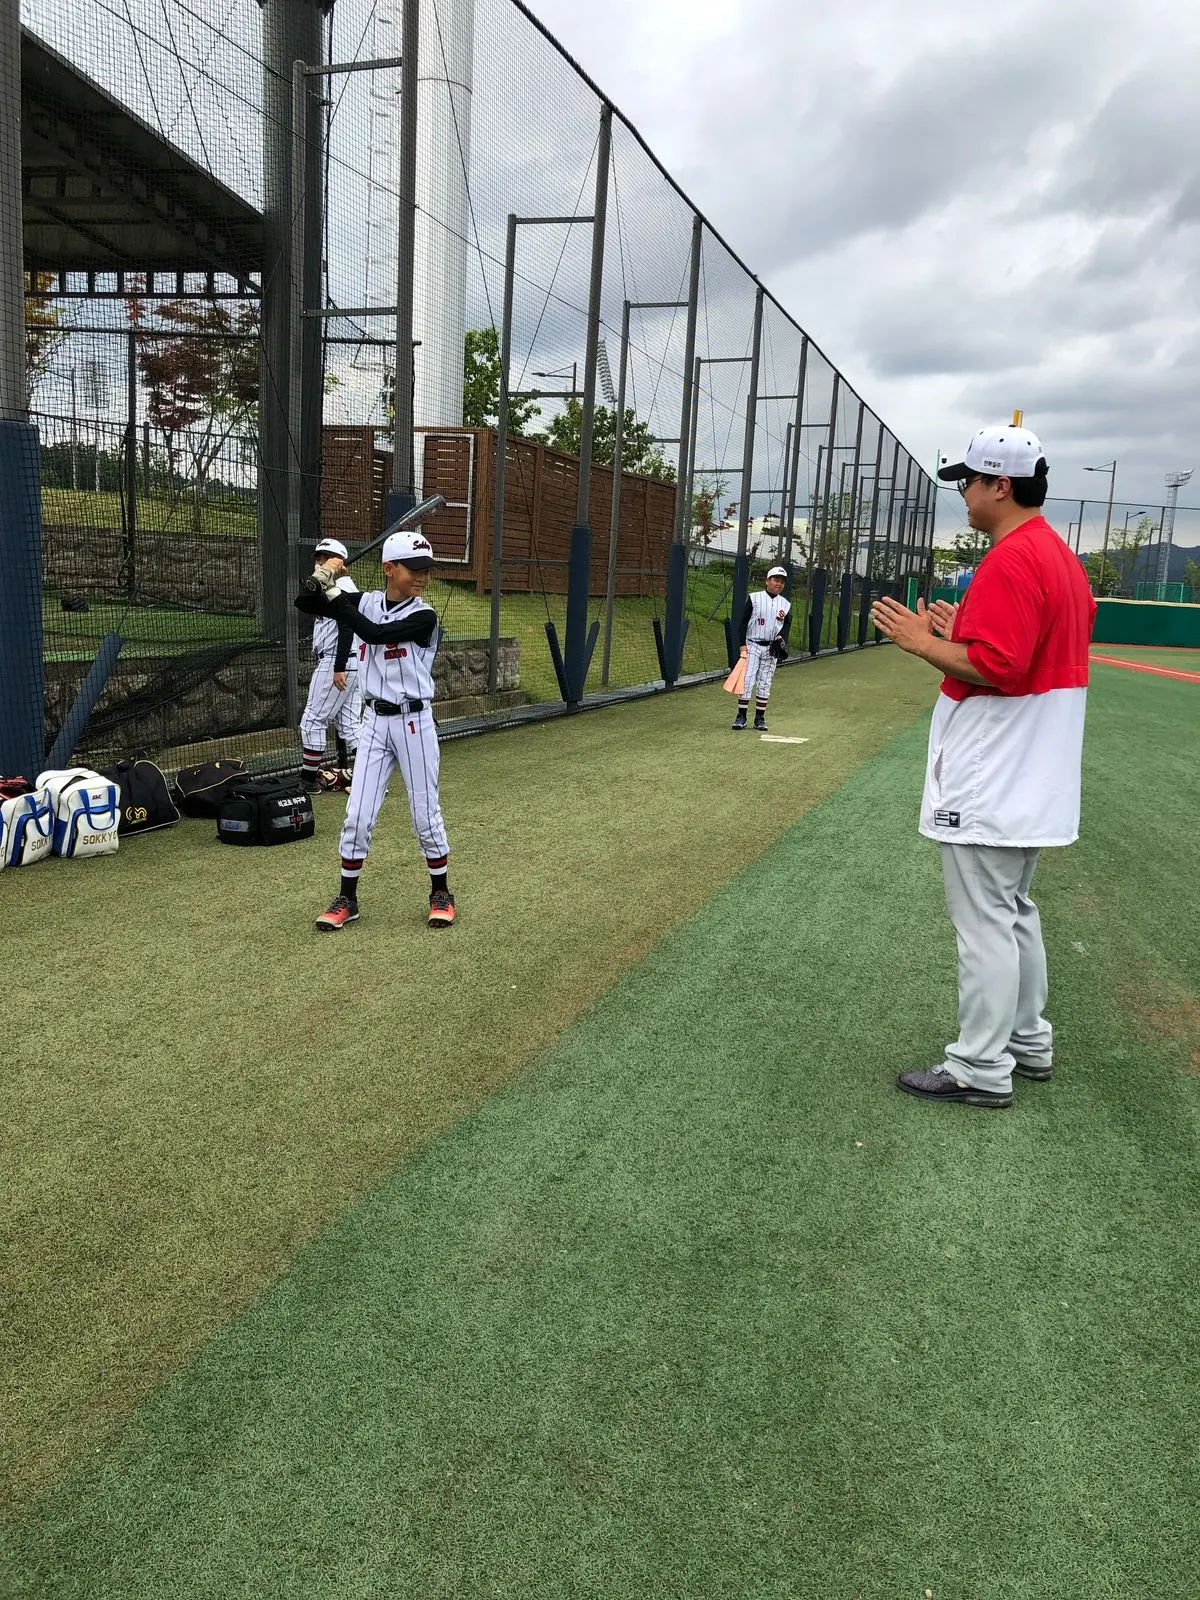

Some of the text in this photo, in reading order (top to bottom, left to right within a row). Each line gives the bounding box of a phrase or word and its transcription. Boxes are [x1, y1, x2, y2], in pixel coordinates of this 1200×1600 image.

[757, 618, 765, 626] 18
[359, 642, 366, 661] 1
[408, 720, 415, 734] 1
